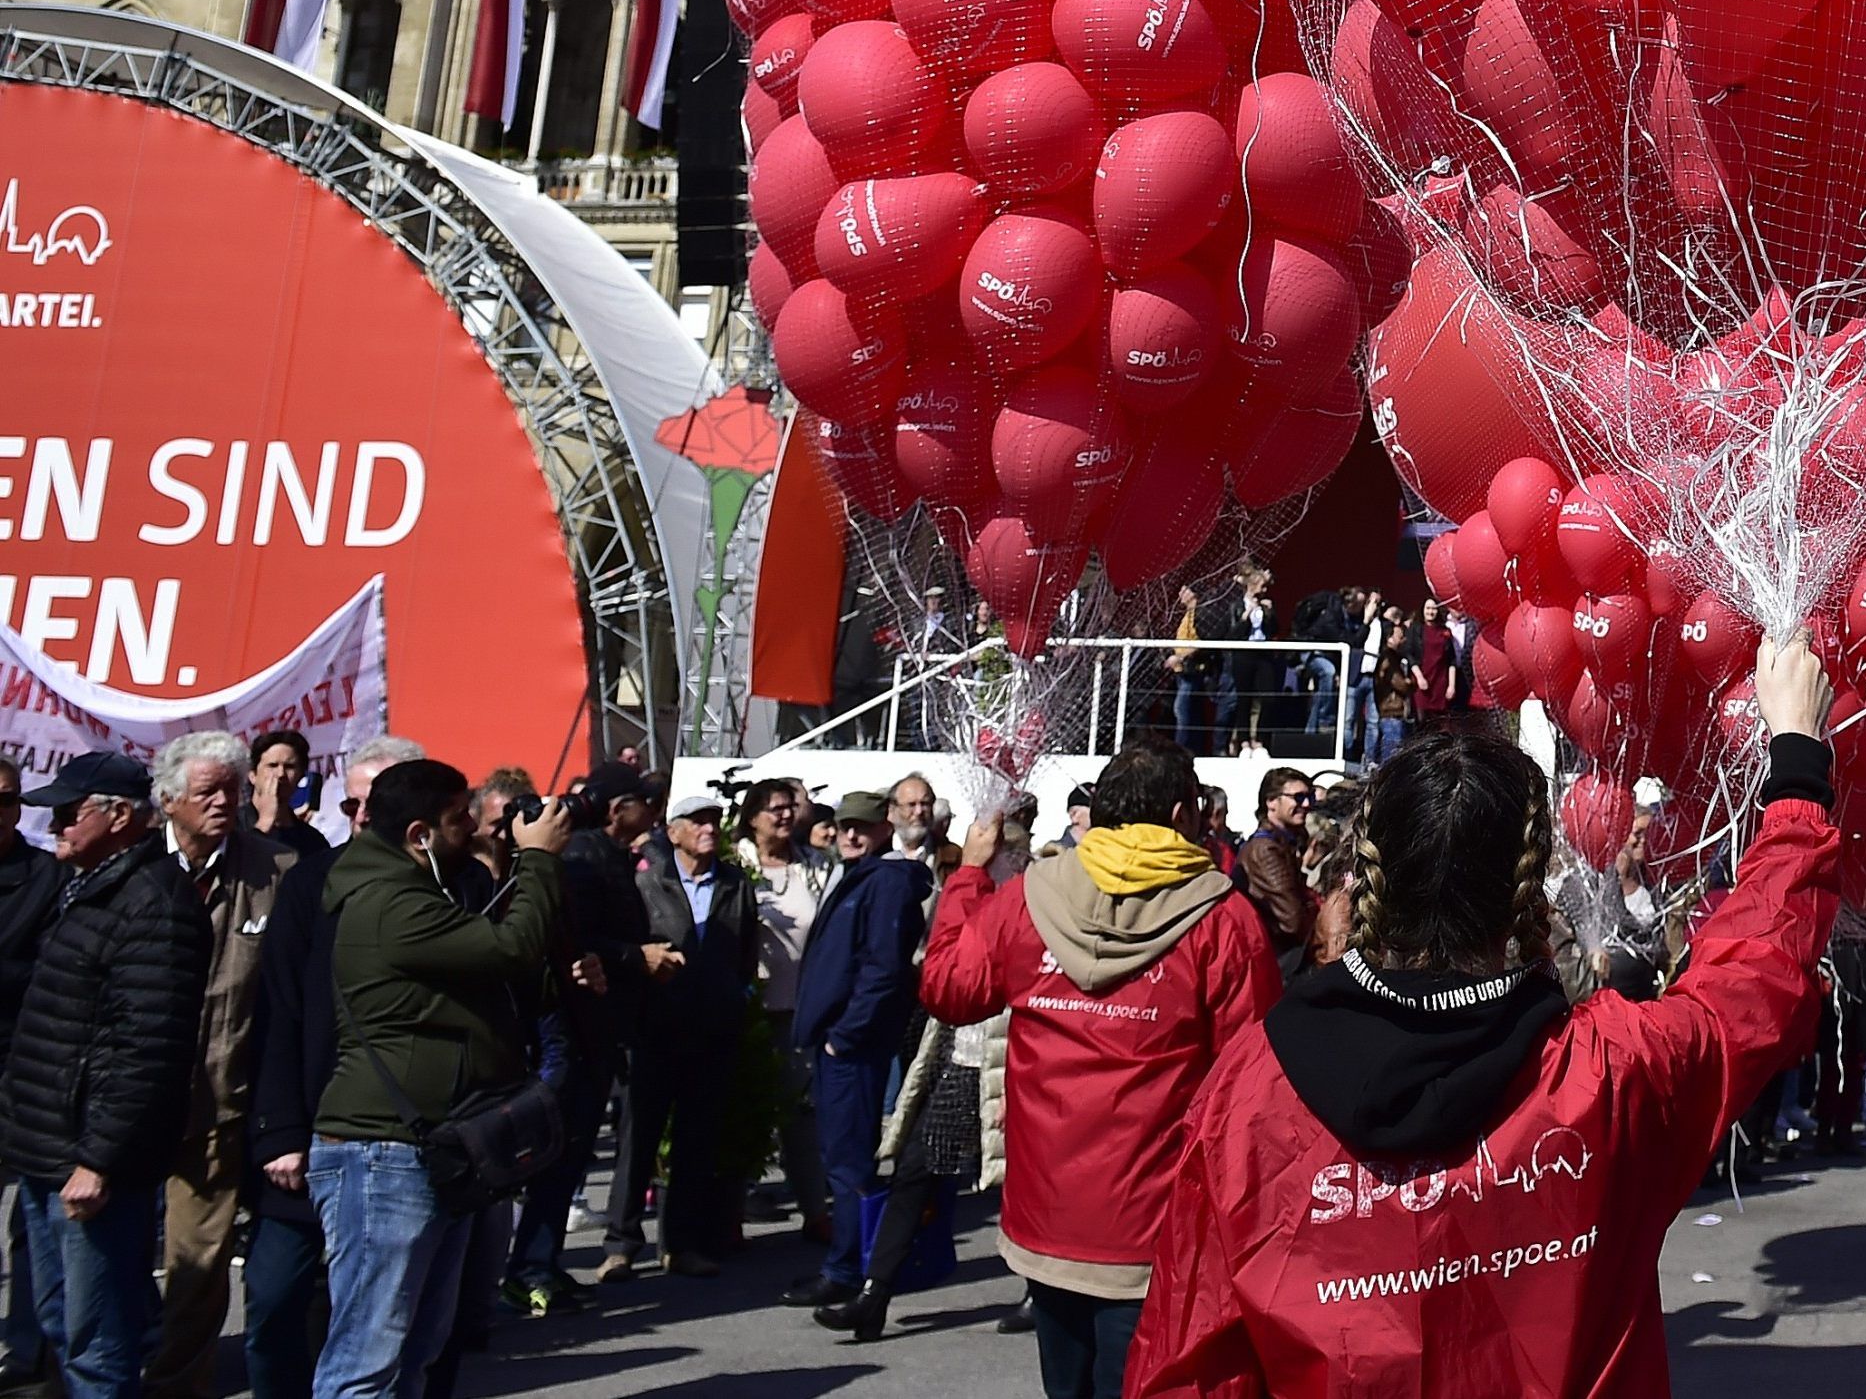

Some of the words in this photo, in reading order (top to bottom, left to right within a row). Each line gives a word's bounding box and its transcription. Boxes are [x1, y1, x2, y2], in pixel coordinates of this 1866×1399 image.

[1137, 8, 1164, 51] SPÖ
[838, 217, 868, 257] SPÖ
[978, 271, 1016, 301] SPÖ
[1126, 350, 1168, 368] SPÖ
[138, 437, 427, 548] SIND
[1573, 611, 1610, 638] SPÖ
[1680, 620, 1708, 642] PÖ
[1423, 987, 1477, 1012] LIVING
[1317, 1225, 1599, 1304] www.wien.spoe.at
